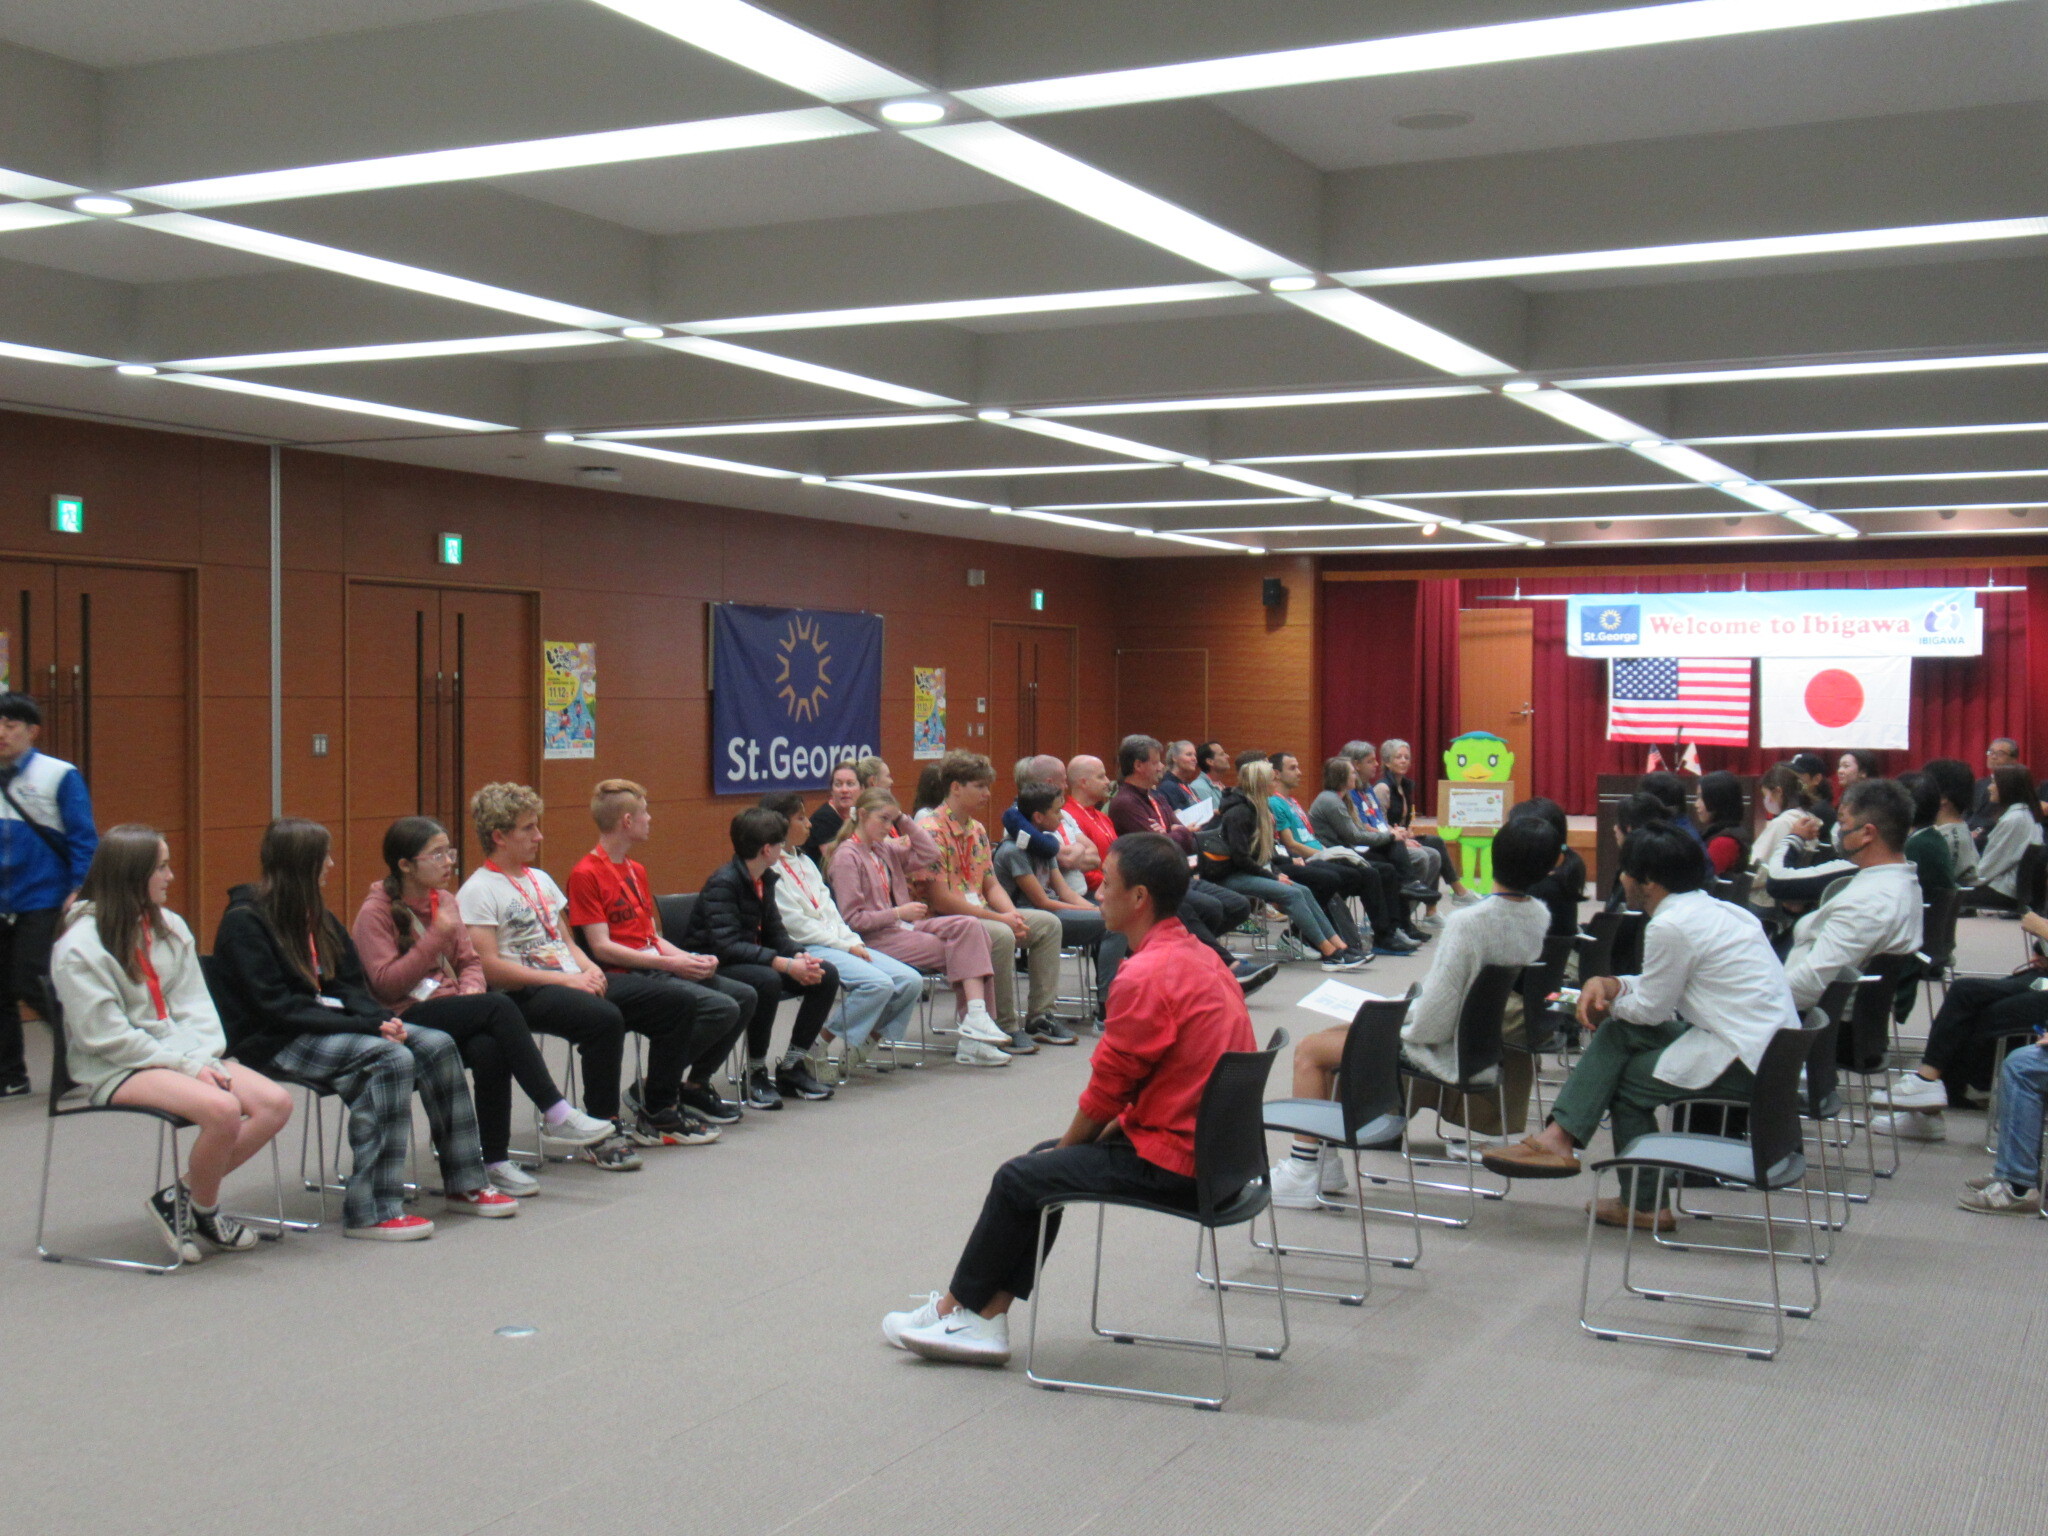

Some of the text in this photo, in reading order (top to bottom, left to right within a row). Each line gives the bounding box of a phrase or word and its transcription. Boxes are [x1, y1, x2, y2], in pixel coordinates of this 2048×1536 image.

[1649, 615, 1910, 638] Welcome to Ibigawa
[1583, 632, 1638, 643] St.George
[1919, 637, 1965, 645] IBIGAWA
